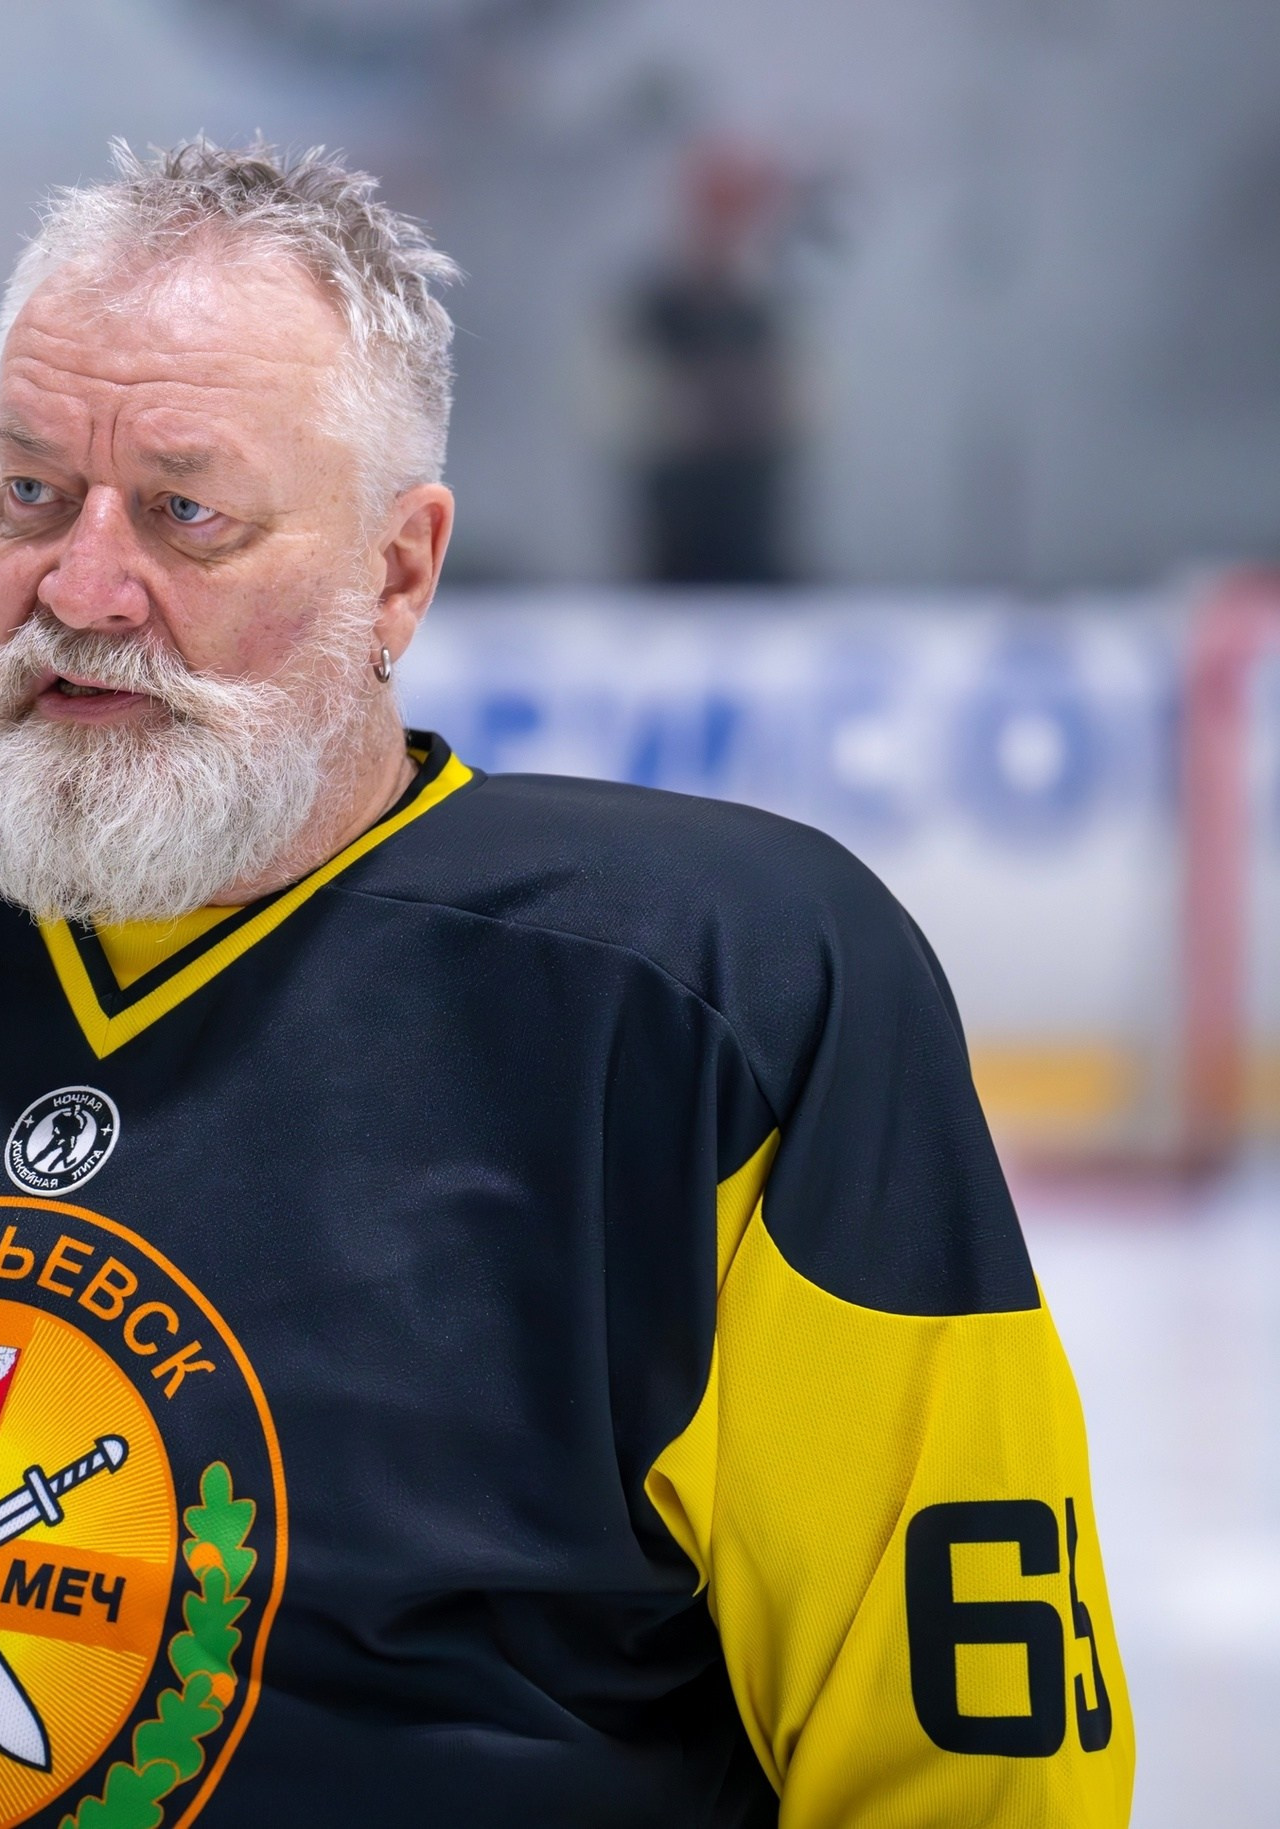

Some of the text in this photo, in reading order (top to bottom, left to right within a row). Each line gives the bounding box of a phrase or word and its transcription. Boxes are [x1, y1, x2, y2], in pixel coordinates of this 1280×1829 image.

[52, 1093, 103, 1113] НОЧНАЯ
[11, 1139, 105, 1189] ХОККЕЙНАЯ ЛИГА
[0, 1559, 126, 1624] МЕЧ
